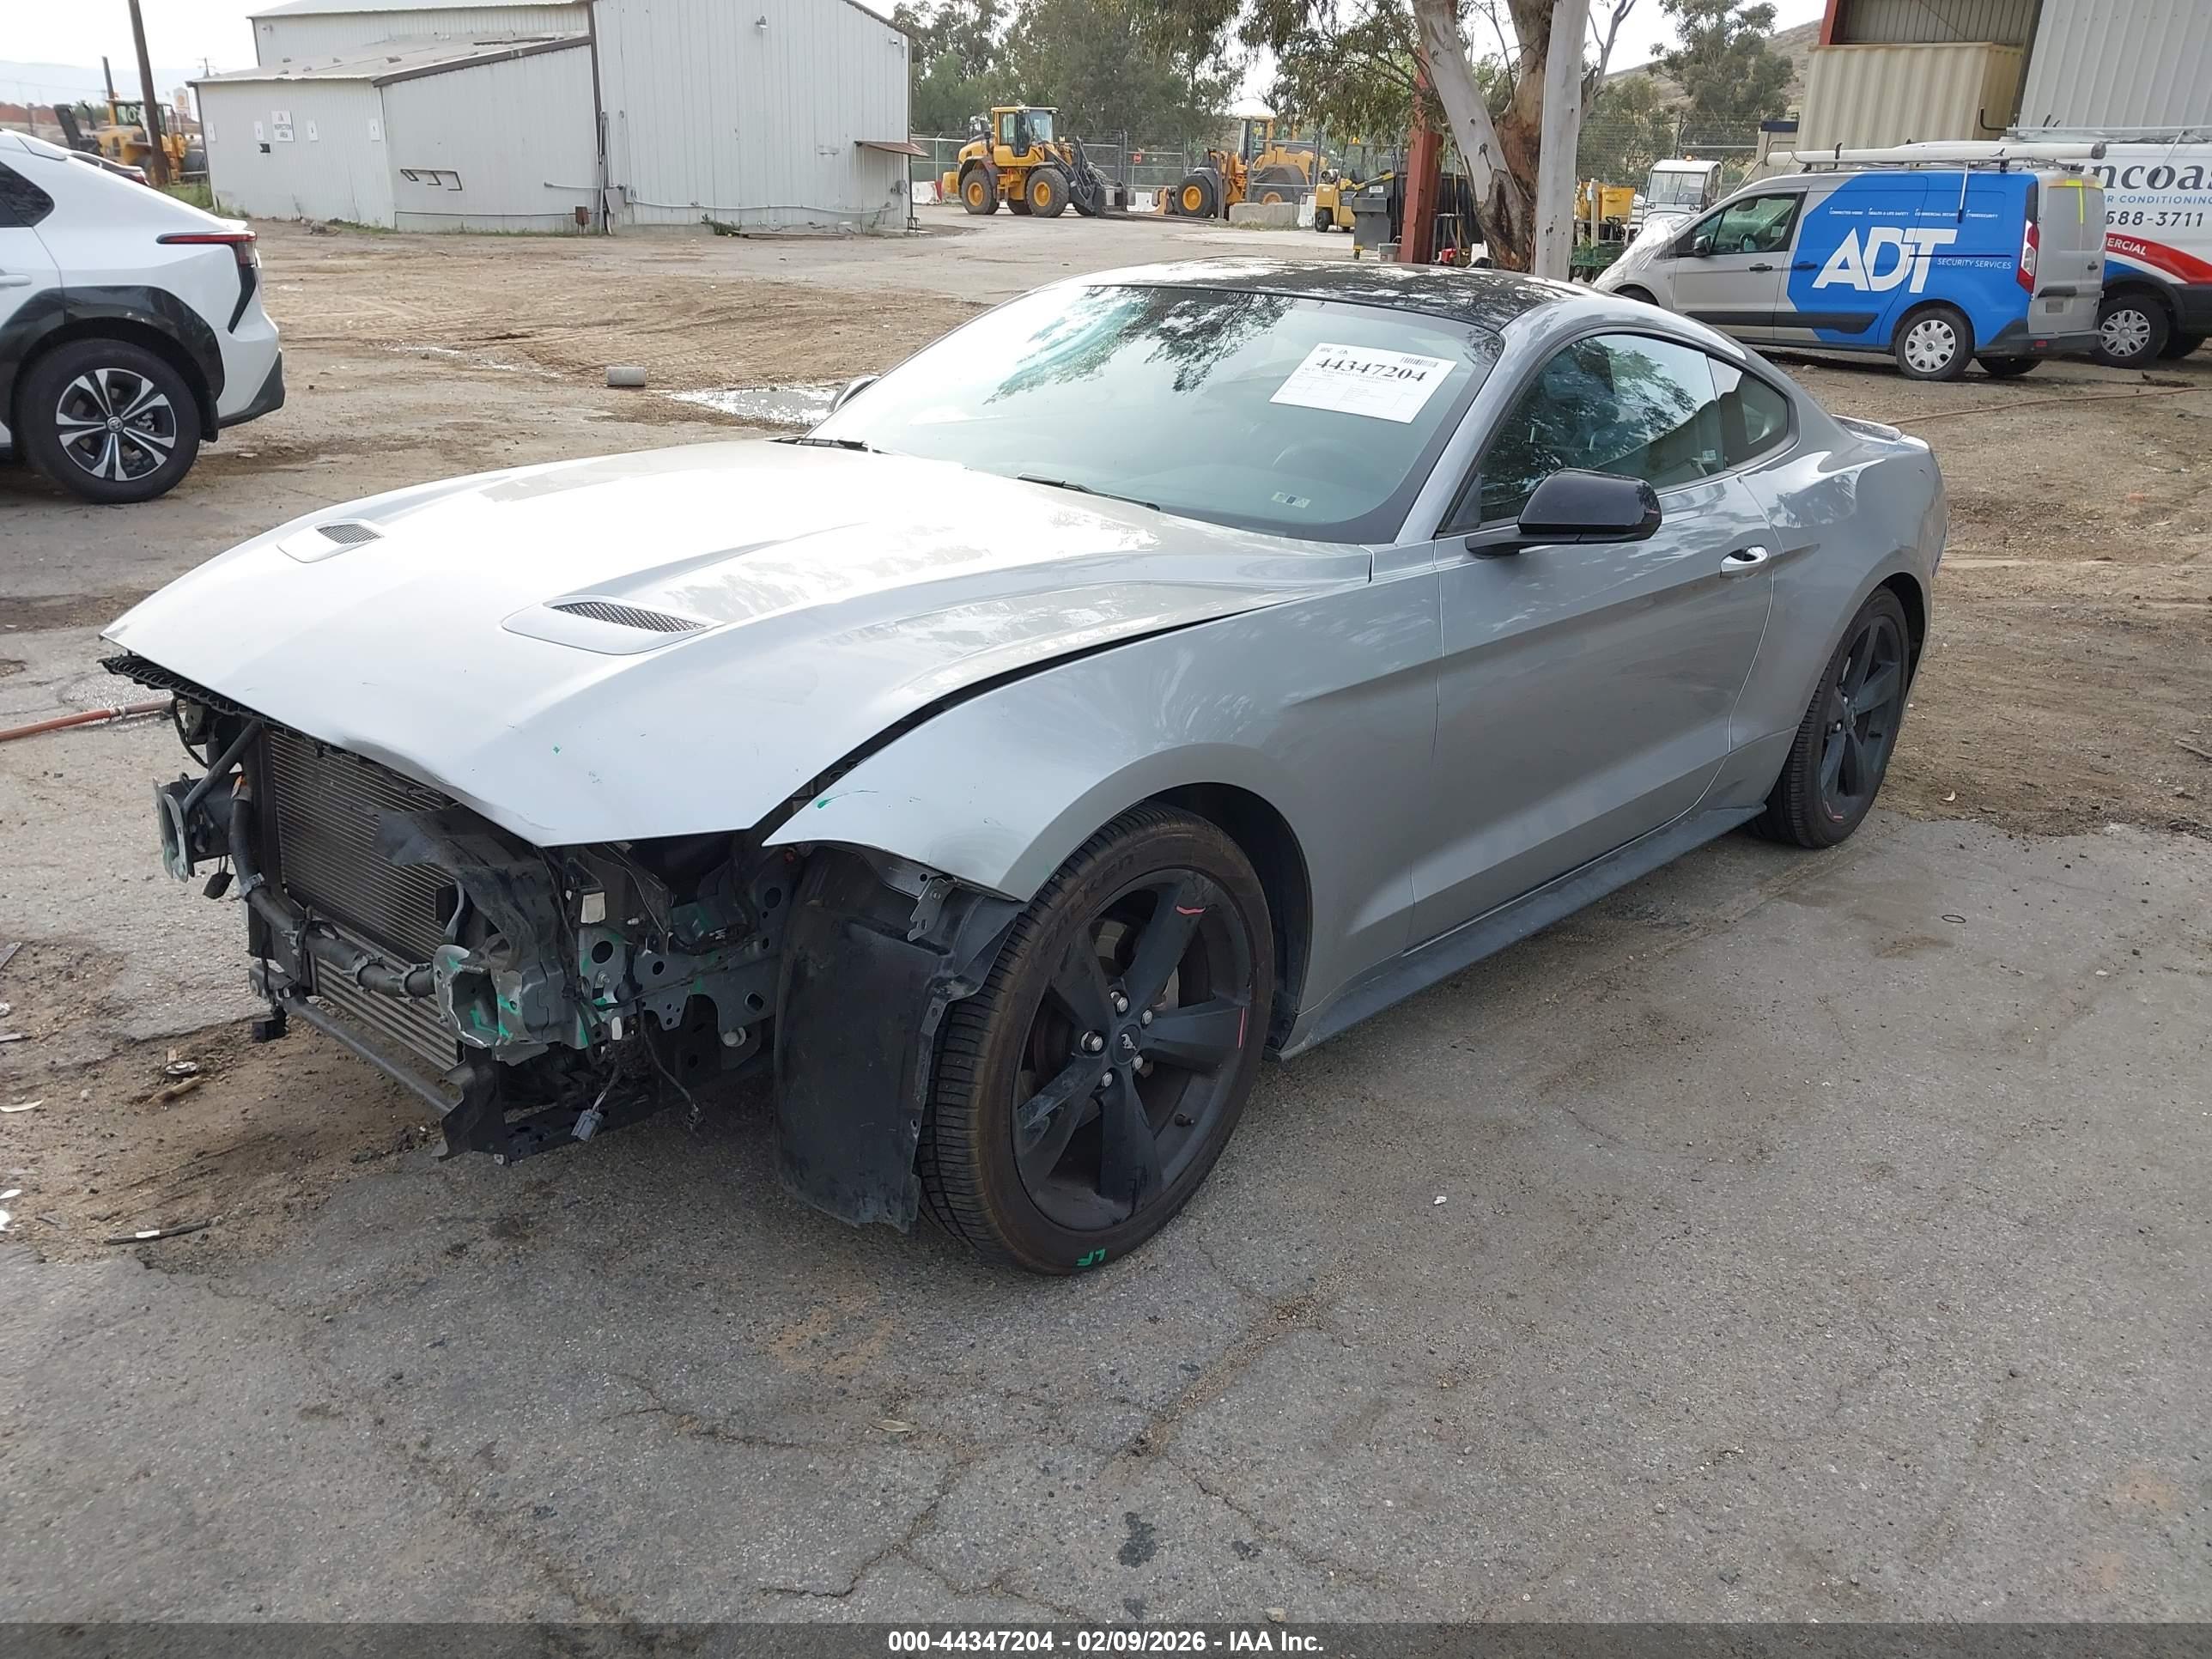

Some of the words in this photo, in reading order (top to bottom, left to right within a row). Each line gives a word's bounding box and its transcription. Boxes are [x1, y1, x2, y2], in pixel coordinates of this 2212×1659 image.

[2106, 210, 2203, 228] 588-3711
[1812, 227, 1958, 294] ADT
[1937, 258, 1973, 267] SECURITY
[1974, 259, 2012, 270] SERVICES
[1316, 357, 1428, 382] 44347204
